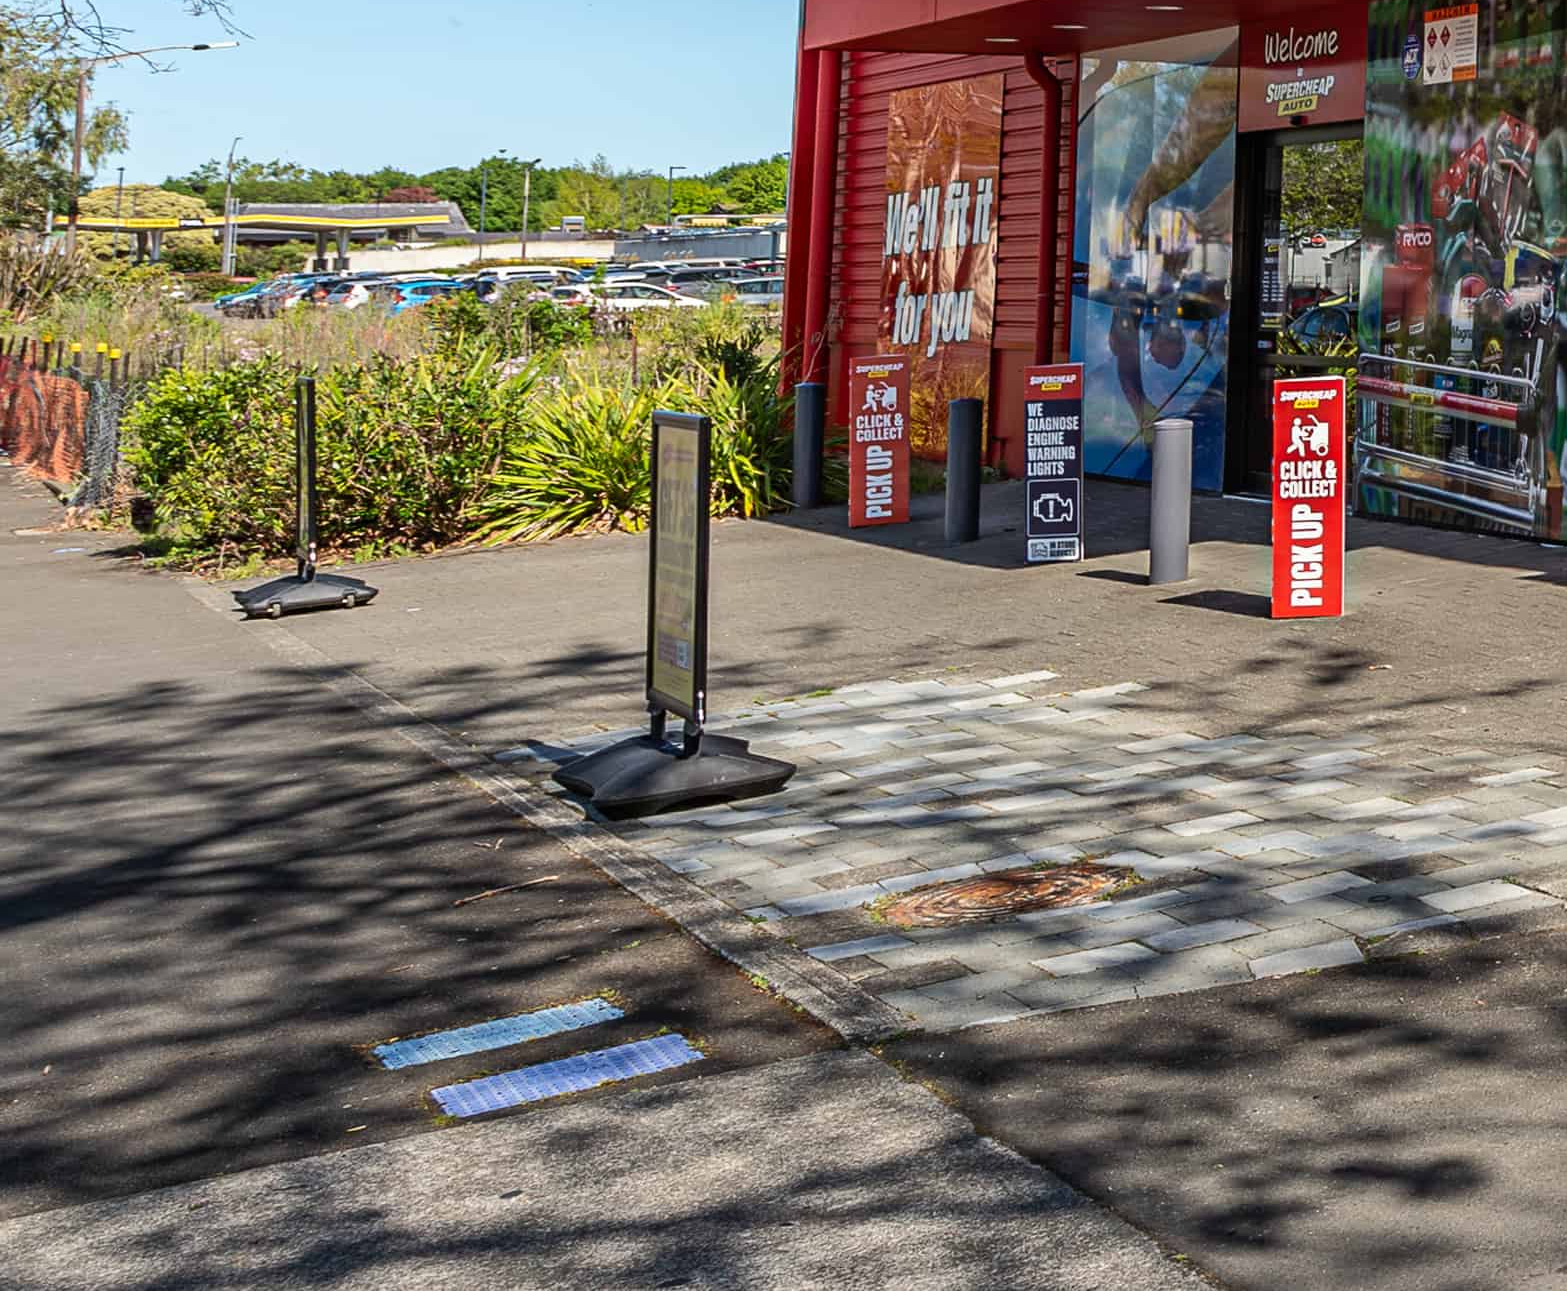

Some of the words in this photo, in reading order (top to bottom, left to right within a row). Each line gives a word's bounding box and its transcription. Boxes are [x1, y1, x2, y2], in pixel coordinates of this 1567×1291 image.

[1264, 28, 1338, 64] Welcome
[1265, 75, 1334, 103] SUPERCHEAP
[1283, 98, 1313, 112] AUTO
[885, 186, 940, 256] We'll
[942, 180, 970, 248] fit
[972, 177, 993, 245] it
[1403, 232, 1432, 246] RYCO
[892, 280, 928, 345] for
[927, 288, 975, 358] you
[1280, 389, 1337, 401] SUPERCHEAP
[1027, 403, 1043, 417] WE
[856, 415, 891, 429] CLICK
[894, 413, 904, 427] &
[1027, 416, 1079, 431] DIAGNOSE
[856, 427, 904, 442] COLLECT
[1027, 431, 1064, 446] ENGINE
[866, 445, 893, 471] UP
[1027, 446, 1076, 461] WARNING
[1027, 461, 1065, 476] LIGHTS
[1280, 460, 1322, 480] CLICK
[1324, 459, 1337, 479] &
[865, 474, 894, 518] PICK
[1280, 479, 1336, 498] COLLECT
[1291, 503, 1323, 540] UP
[1290, 544, 1323, 607] PICK
